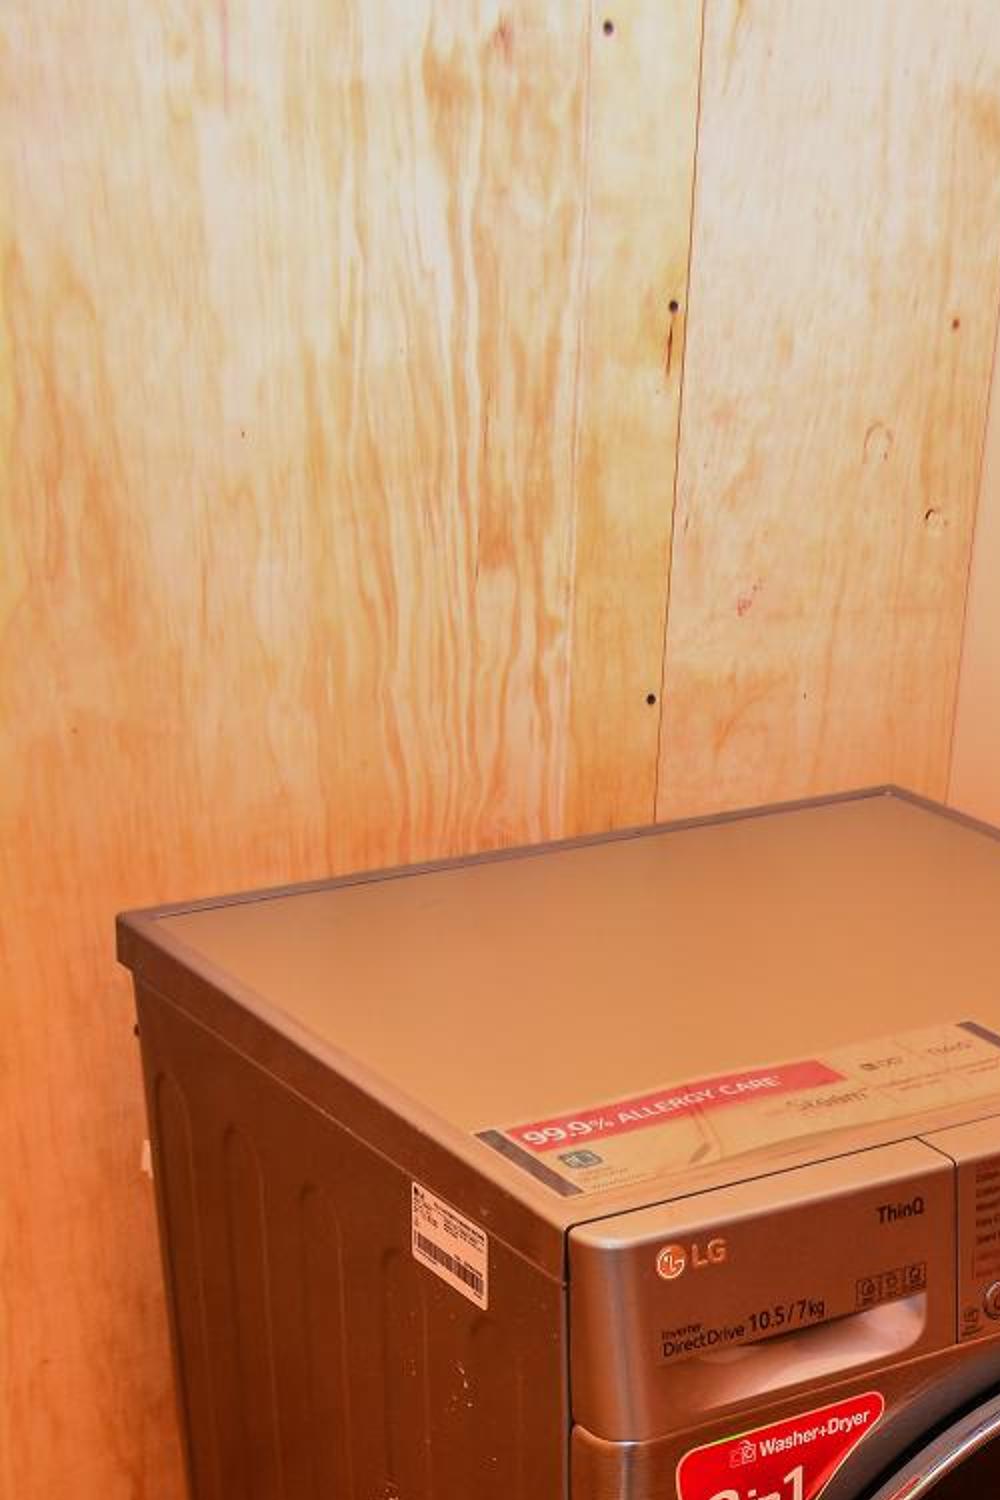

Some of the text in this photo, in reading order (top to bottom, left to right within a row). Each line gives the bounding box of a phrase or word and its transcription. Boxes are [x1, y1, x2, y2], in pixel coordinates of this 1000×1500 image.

[522, 1117, 615, 1146] 99.9%
[617, 1088, 714, 1124] ALLERGY
[876, 1196, 925, 1225] ThinQ
[691, 1238, 728, 1268] LG
